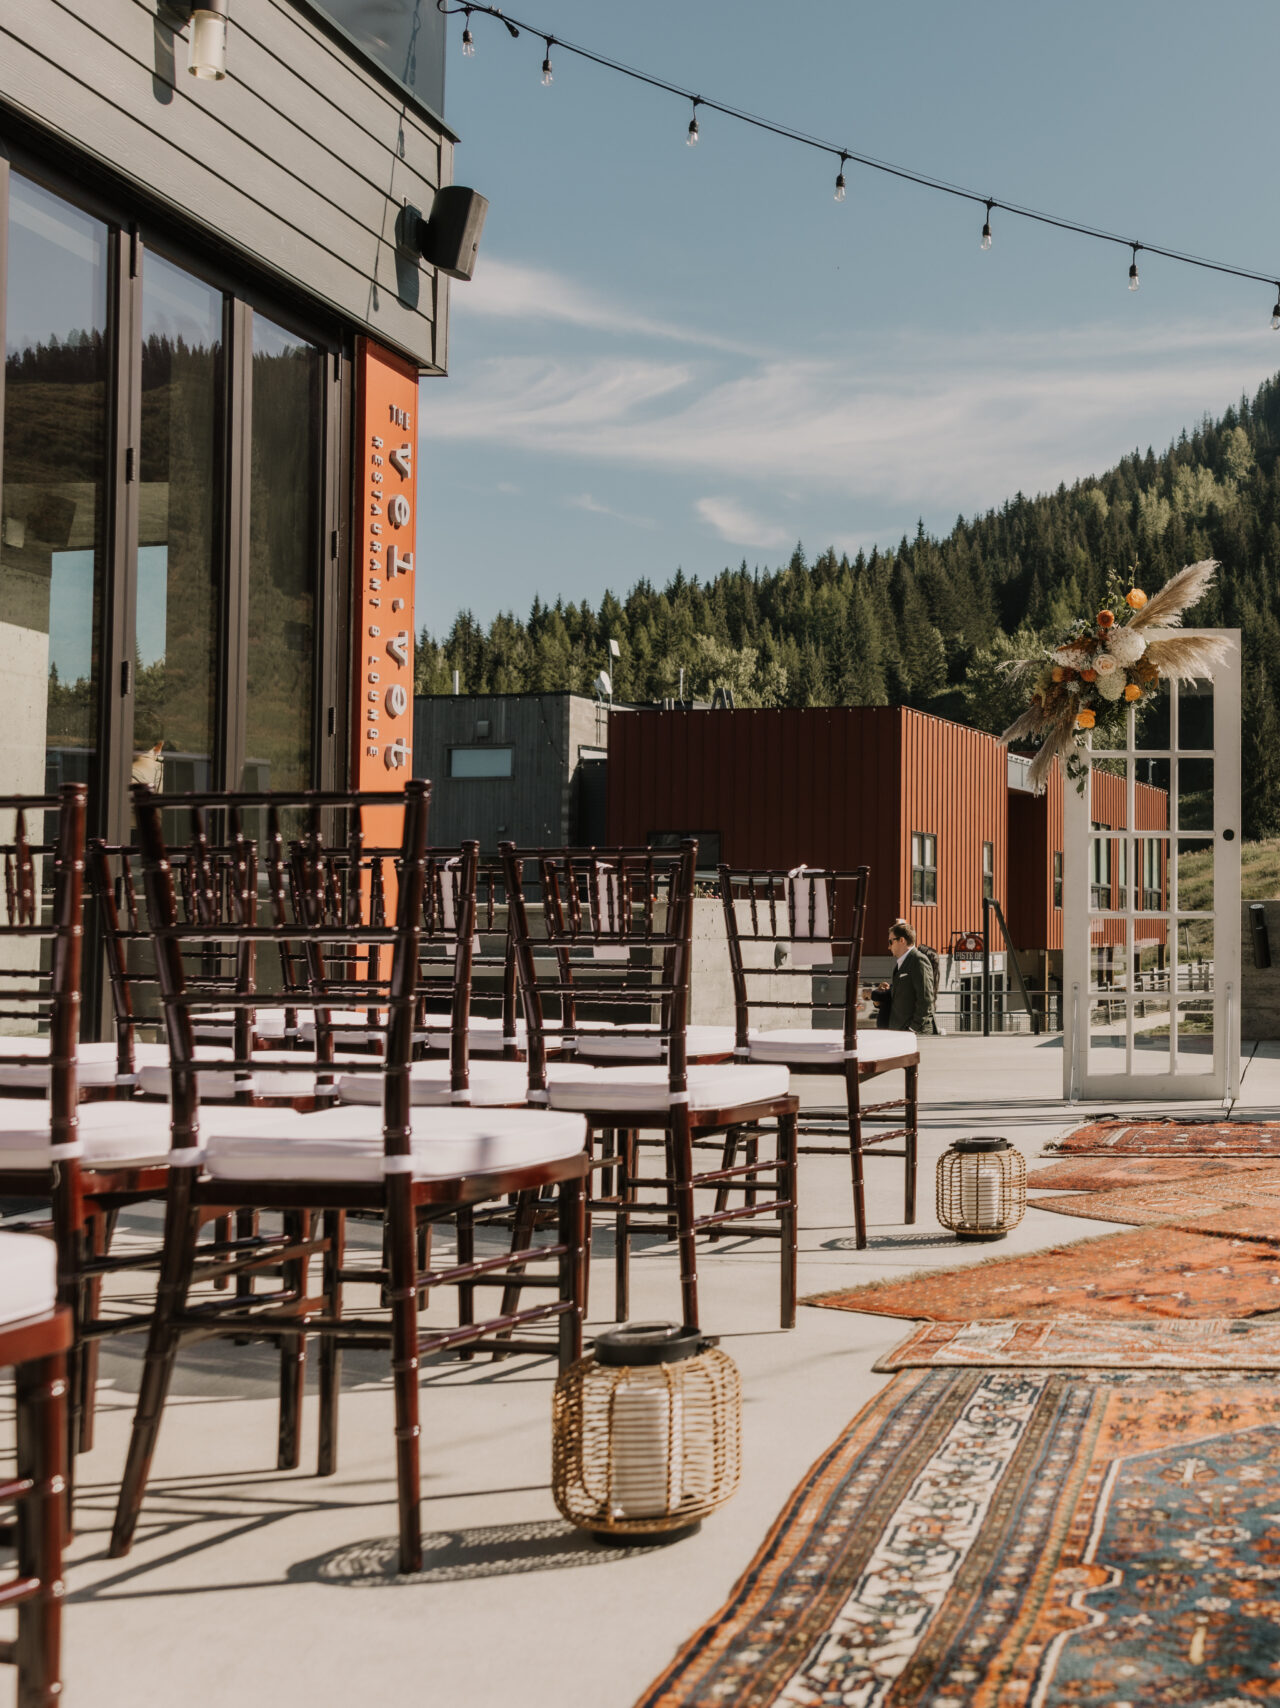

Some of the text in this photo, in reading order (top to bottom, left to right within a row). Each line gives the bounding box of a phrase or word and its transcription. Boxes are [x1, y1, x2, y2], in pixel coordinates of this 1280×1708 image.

[389, 404, 411, 431] THE
[367, 436, 384, 758] RESTAURANT & LOUNGE
[955, 951, 984, 960] PISTE OF
